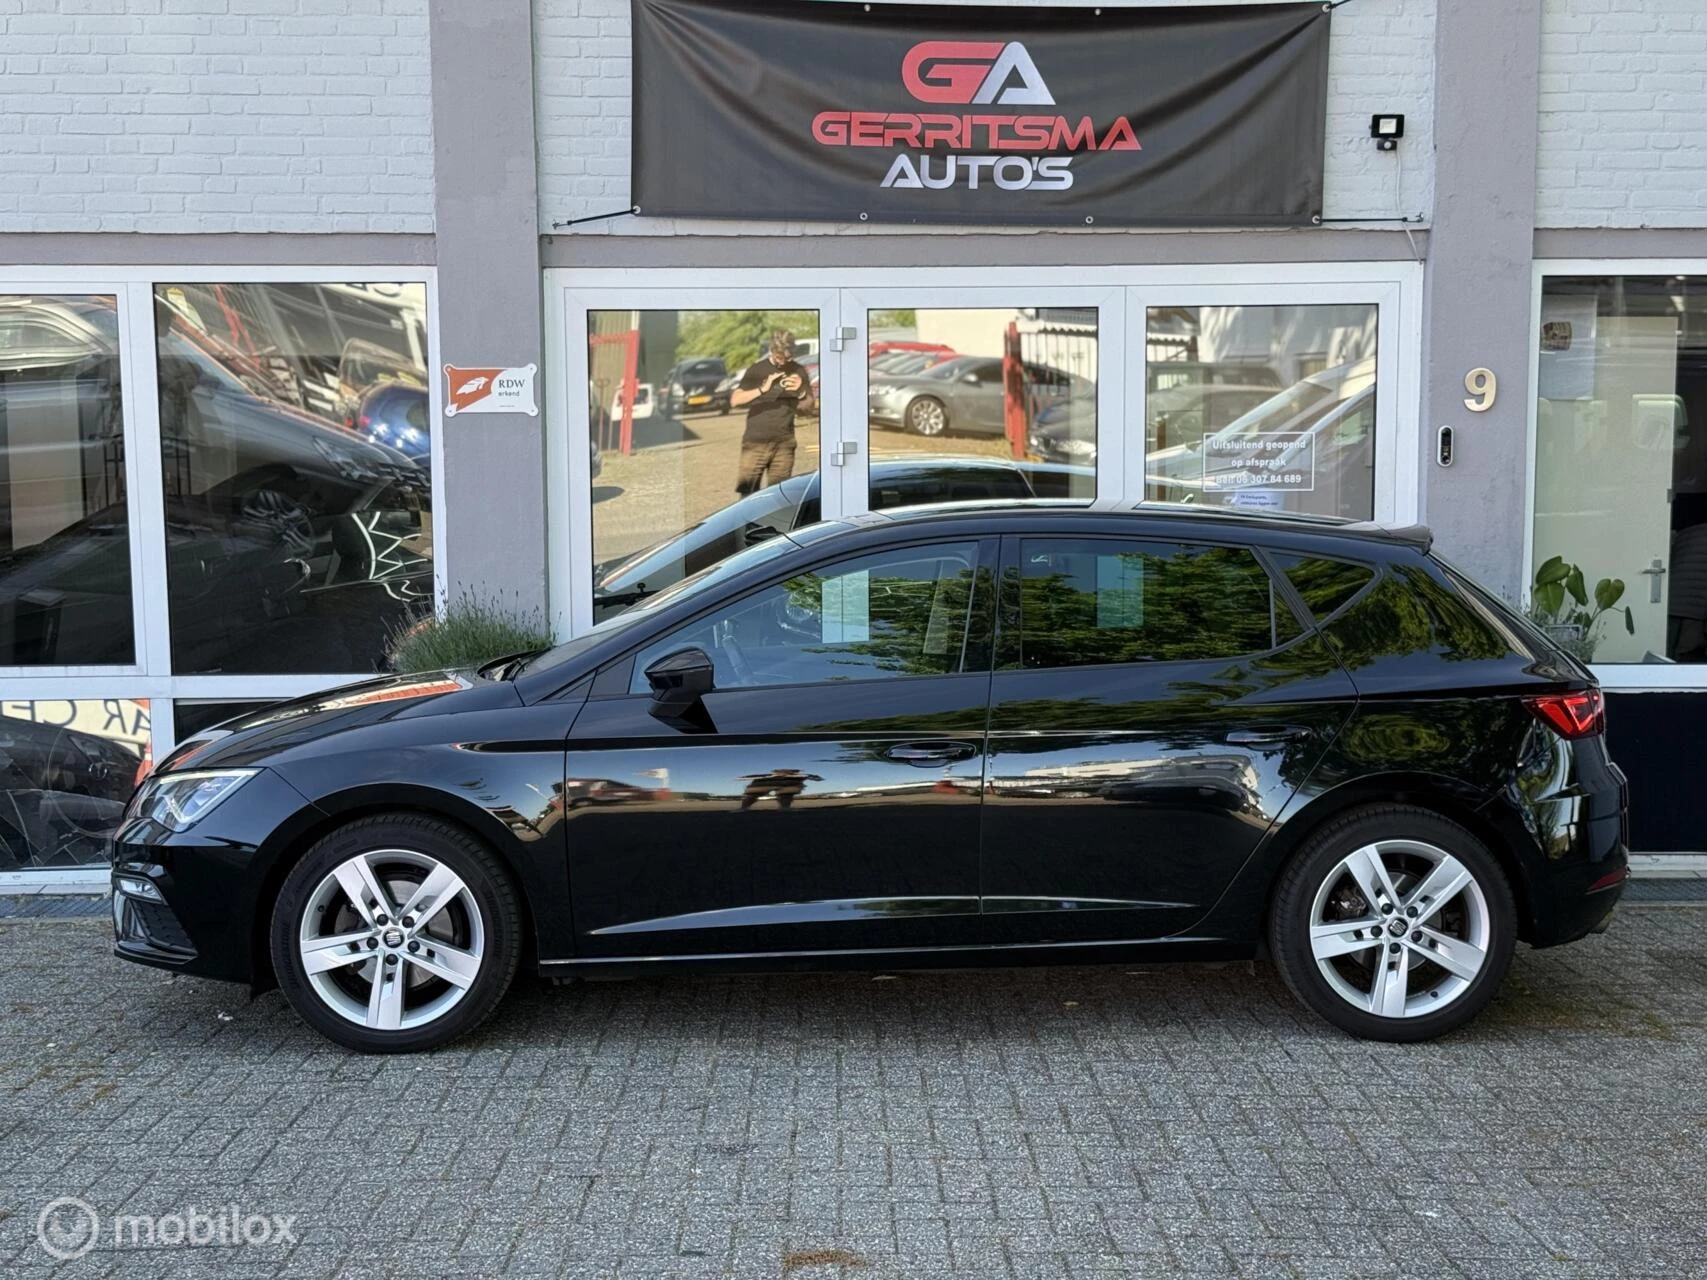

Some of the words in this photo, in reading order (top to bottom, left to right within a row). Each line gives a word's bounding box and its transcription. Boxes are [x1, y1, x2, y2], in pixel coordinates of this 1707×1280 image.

[902, 41, 1056, 105] GA
[812, 111, 1142, 150] GERRITSMA
[879, 153, 1074, 191] AUTO'S
[498, 379, 525, 389] RDW
[1463, 367, 1496, 412] 9
[1212, 440, 1264, 449] Uitsluitend
[1265, 440, 1306, 451] geopend
[1231, 460, 1243, 468] op
[1246, 458, 1287, 468] afspraak
[1250, 474, 1267, 484] 307
[1284, 474, 1302, 483] 689
